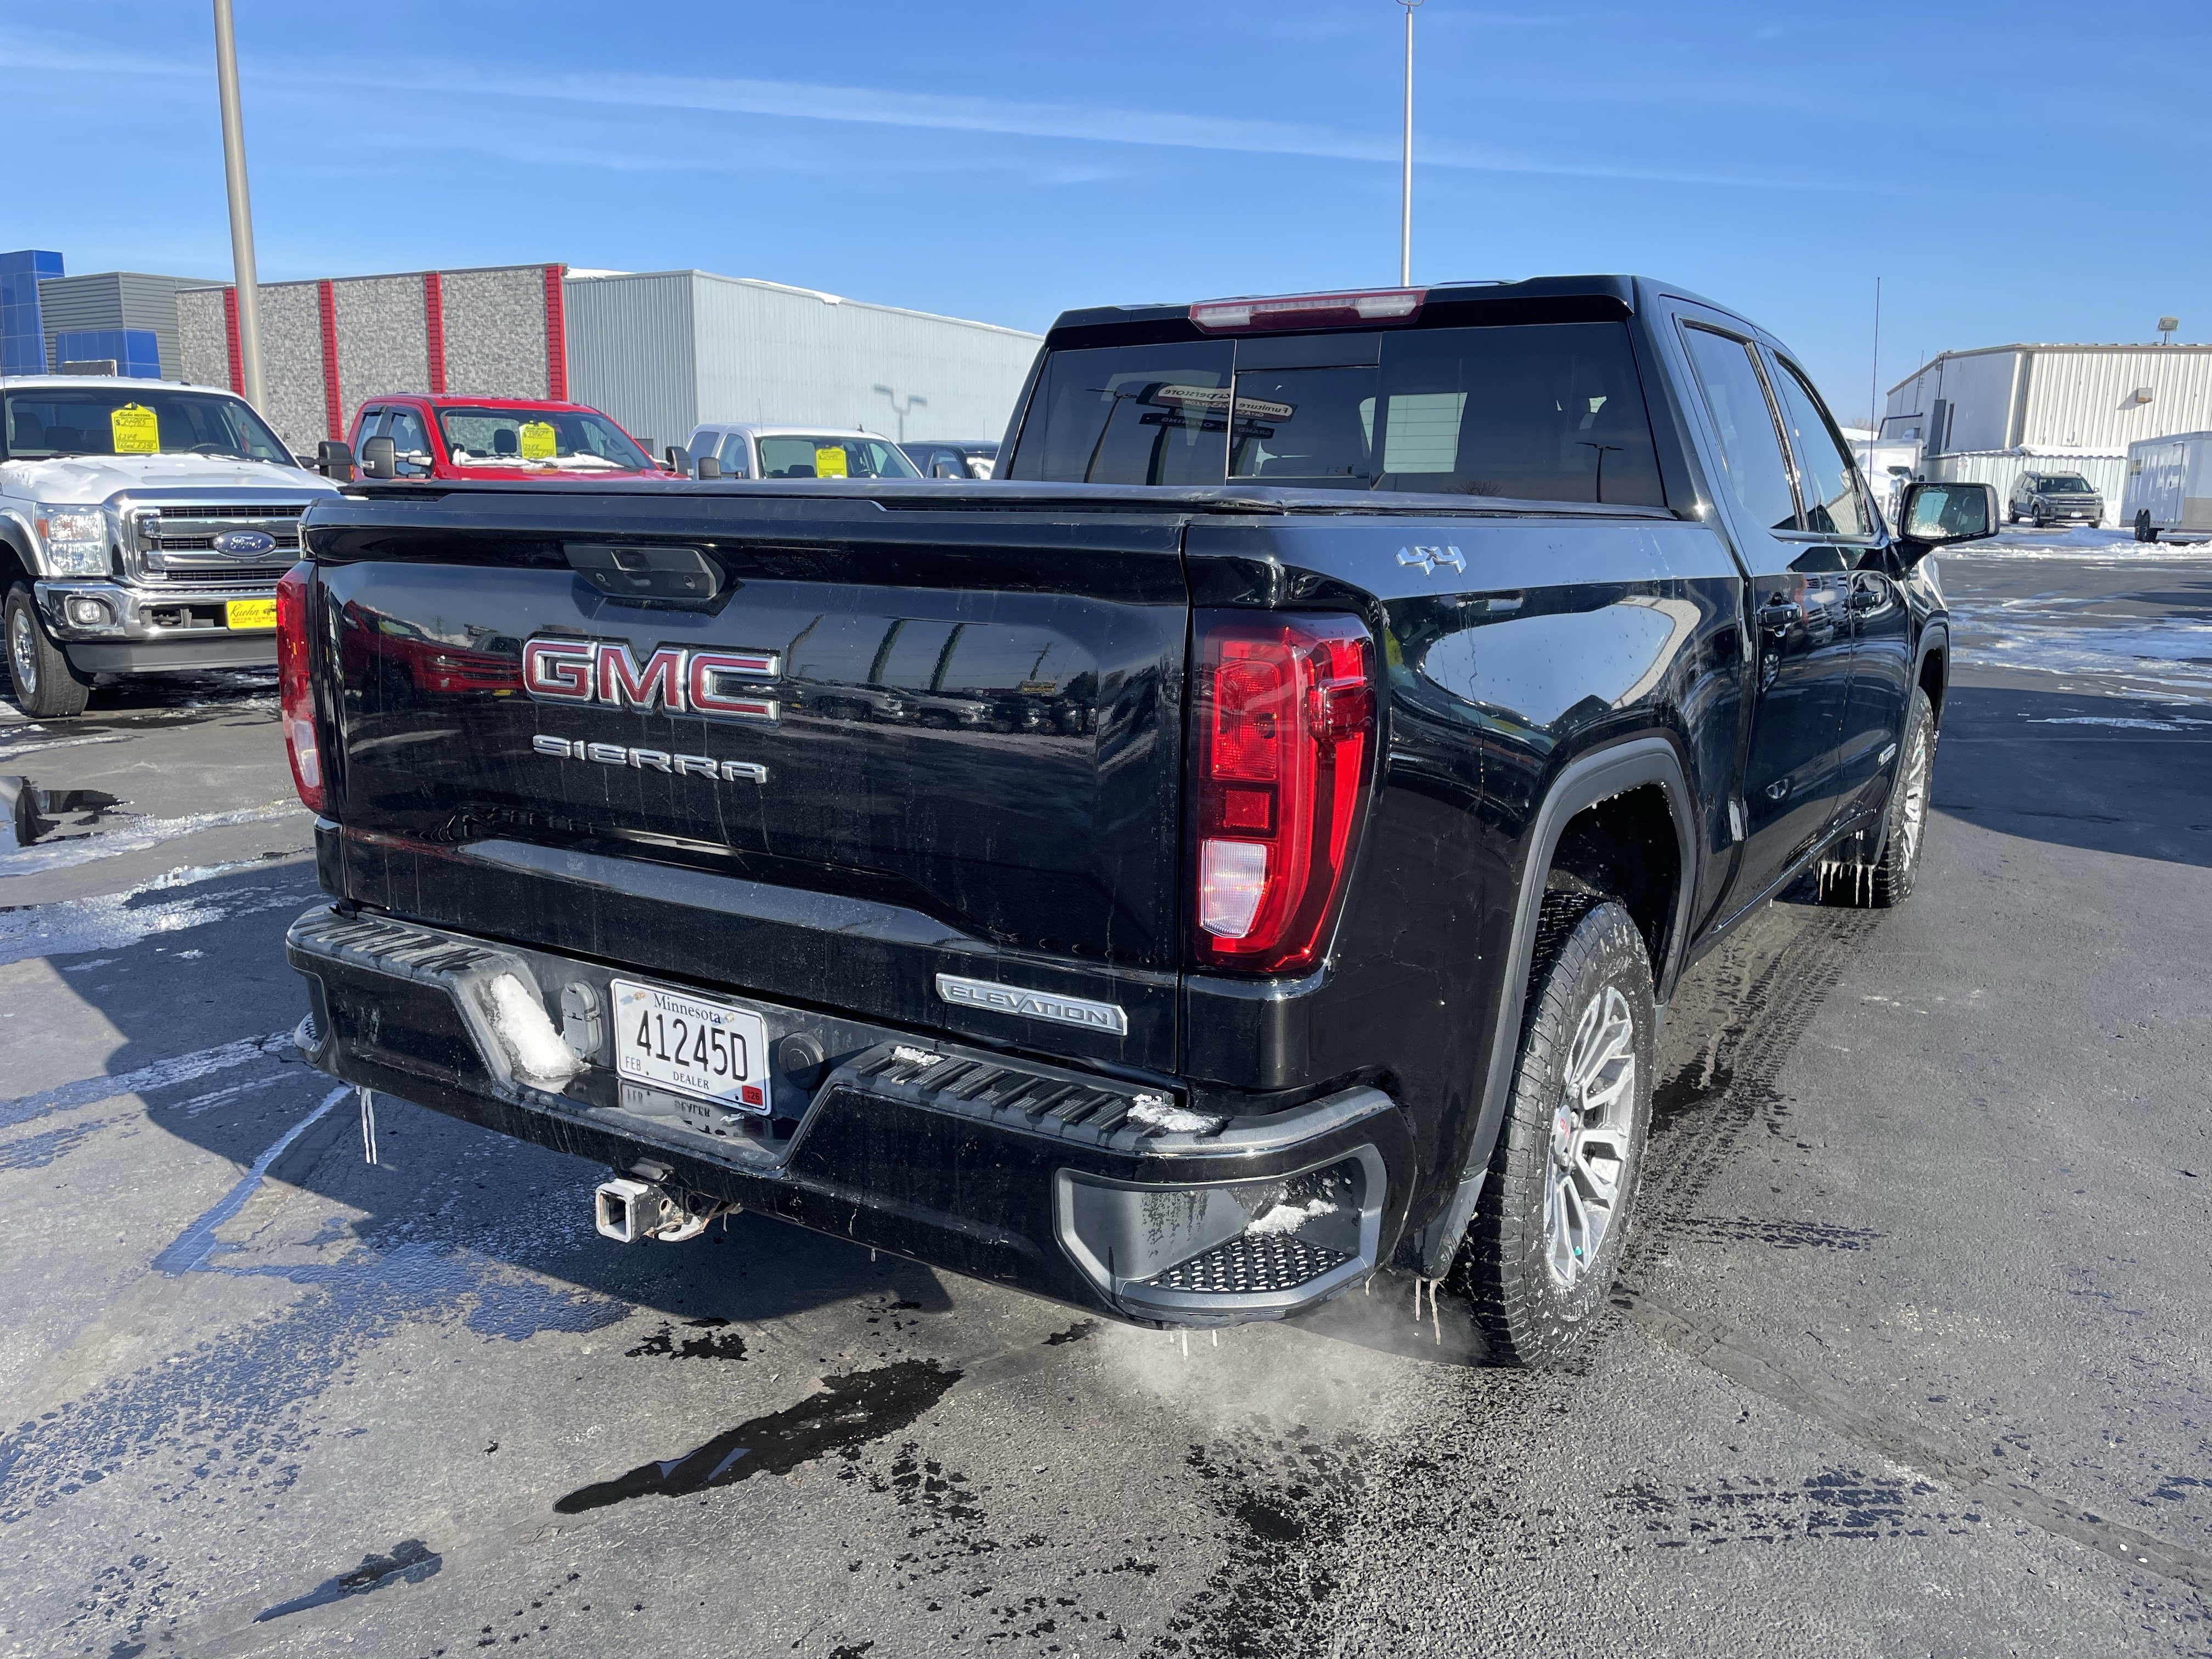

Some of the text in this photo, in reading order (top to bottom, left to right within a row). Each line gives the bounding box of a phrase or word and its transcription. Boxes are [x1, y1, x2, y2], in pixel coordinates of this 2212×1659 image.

[230, 603, 259, 618] Kuehn
[523, 637, 781, 721] GMC
[533, 734, 769, 785] SIERRA
[654, 993, 721, 1024] Minnesota
[950, 985, 1111, 1026] ELEVATION
[636, 1010, 748, 1082] 41245D
[625, 1056, 641, 1071] FEB
[673, 1071, 710, 1090] DEALER
[751, 1091, 760, 1101] 26
